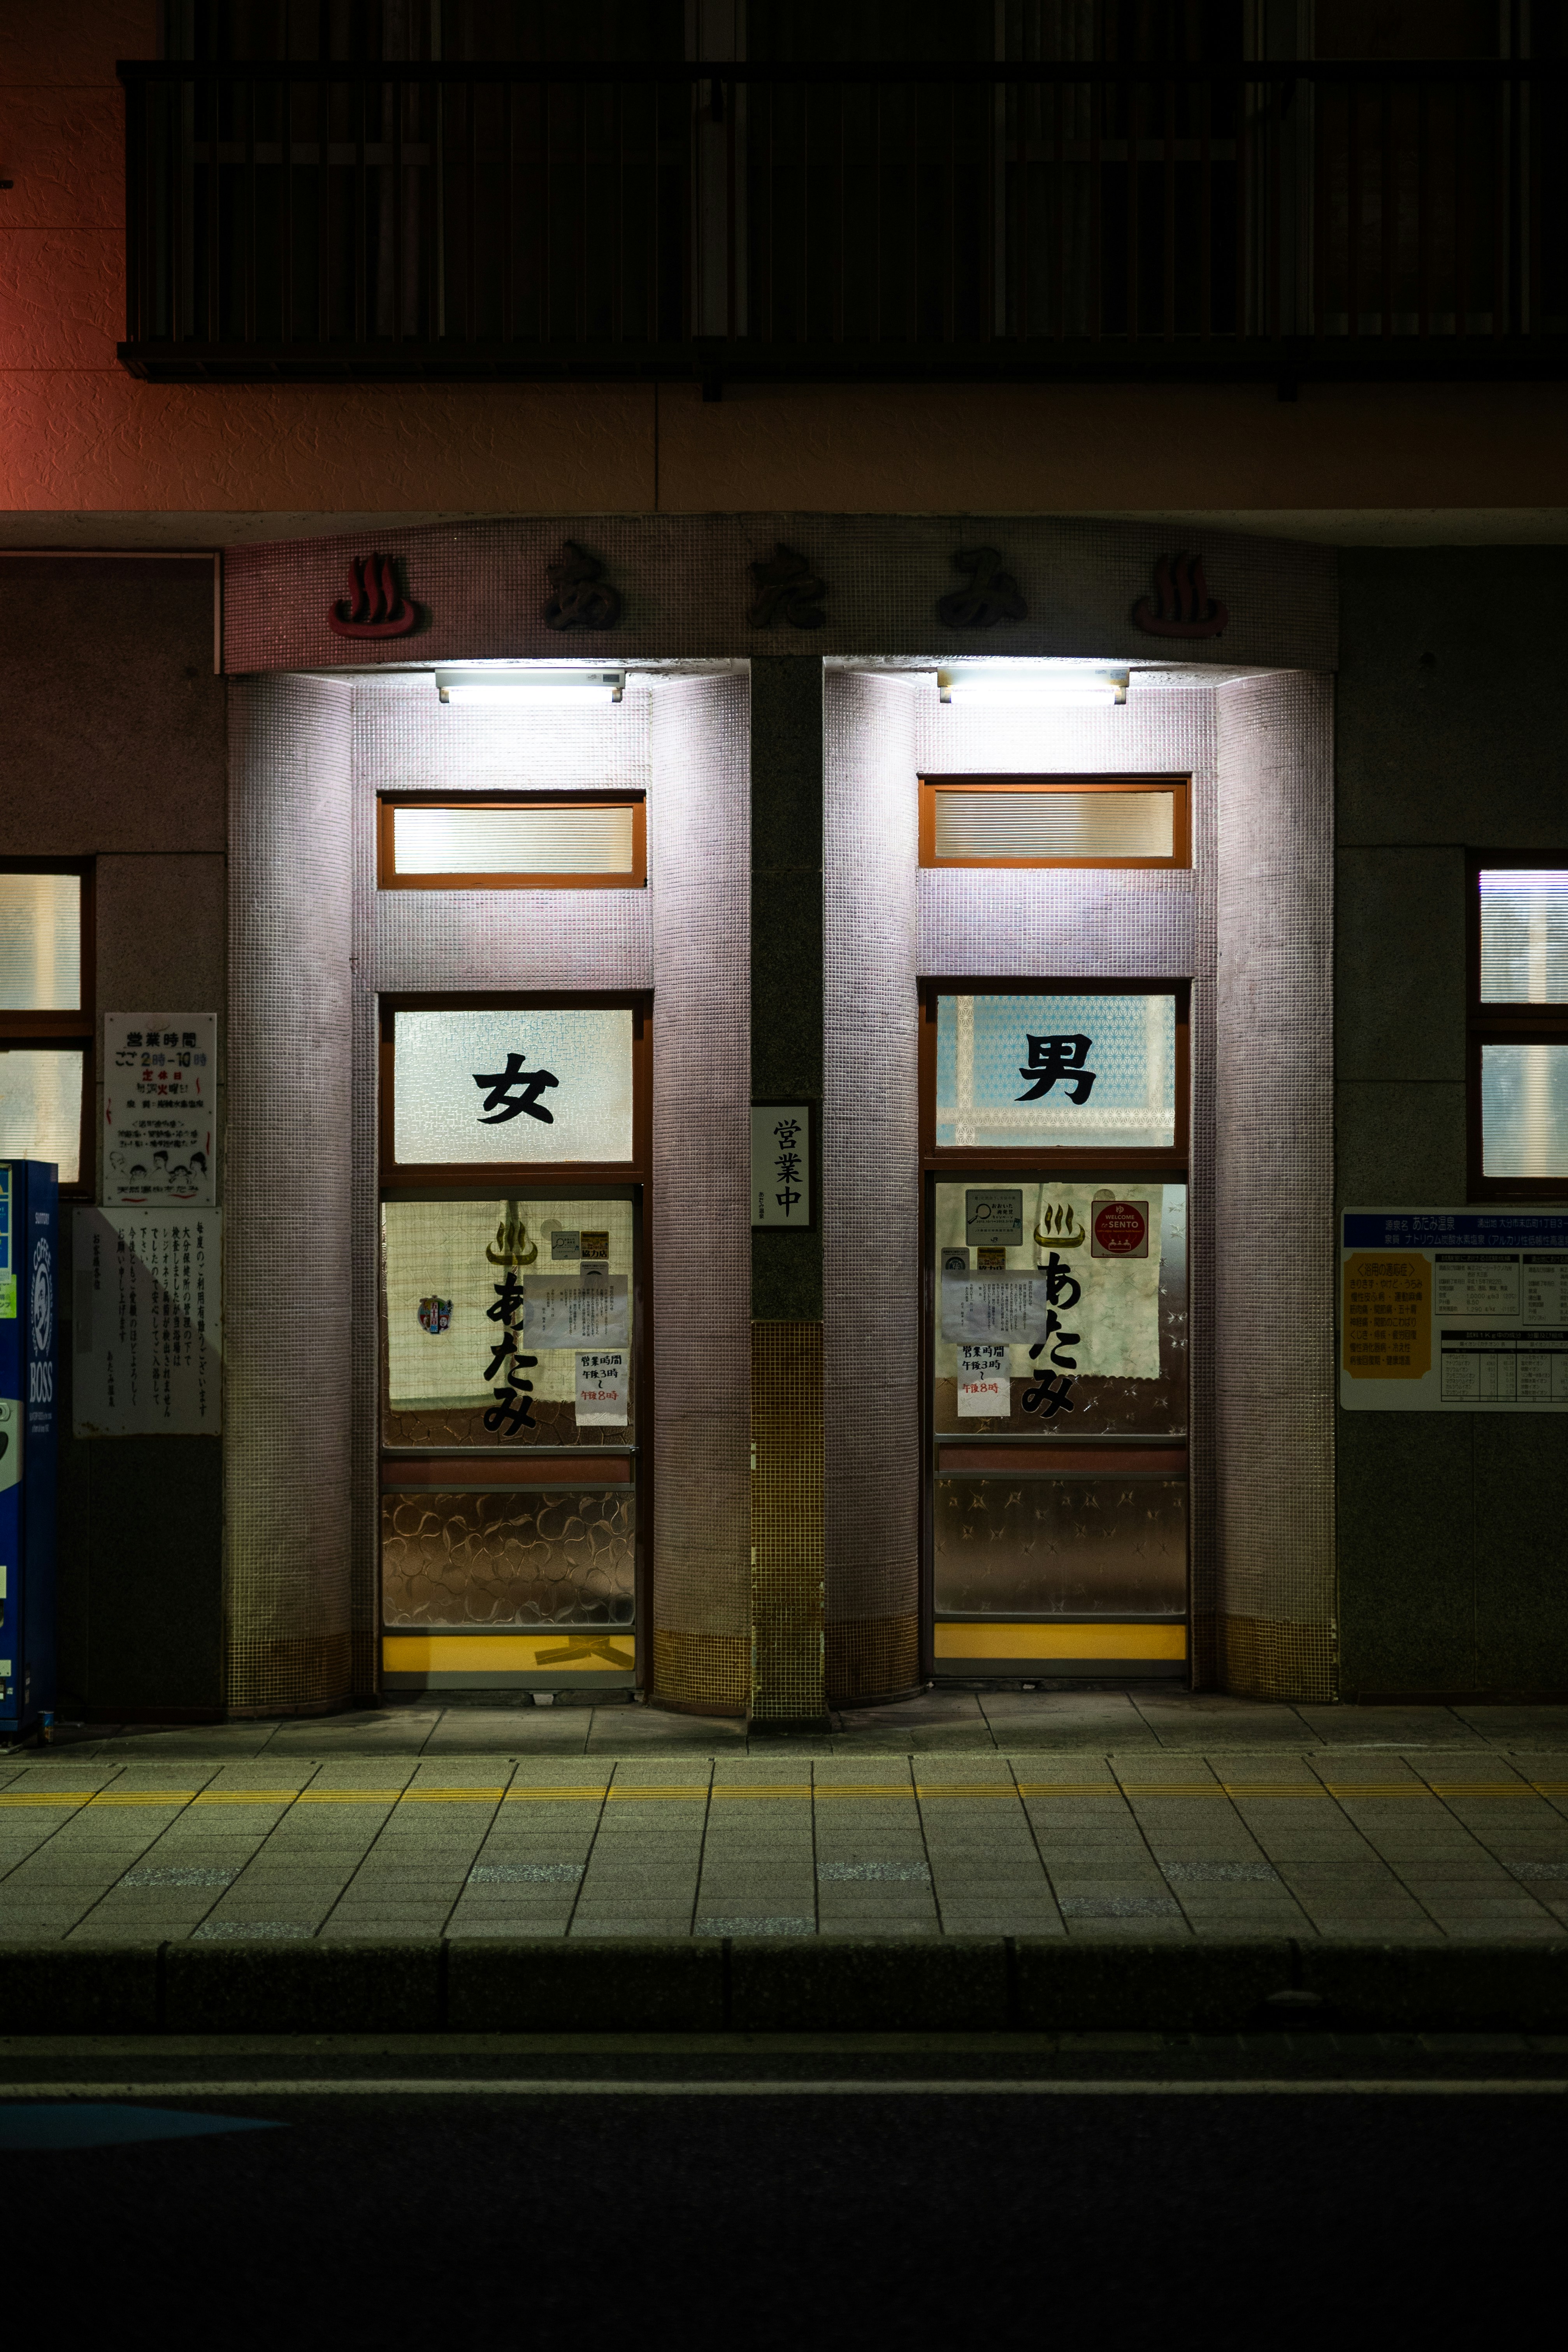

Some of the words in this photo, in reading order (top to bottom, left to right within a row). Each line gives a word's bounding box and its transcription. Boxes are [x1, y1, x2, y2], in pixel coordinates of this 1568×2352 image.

[127, 1032, 196, 1047] 営業時間
[142, 1069, 181, 1081] 定休日
[1015, 1033, 1097, 1105] 男
[471, 1052, 559, 1125] 女
[773, 1119, 803, 1217] 営業中
[1385, 1220, 1408, 1231] 源泉名
[1413, 1216, 1455, 1231] あたみ温泉
[1477, 1219, 1497, 1228] 湧出地
[1385, 1235, 1400, 1245] 泉質
[1022, 1251, 1081, 1418] あたみ
[483, 1272, 538, 1437] あたみ
[963, 1346, 1004, 1358] 営業時間
[581, 1355, 622, 1367] 営業時間
[962, 1360, 1001, 1370] 午後3時
[582, 1368, 618, 1379] 午後3時
[30, 1361, 53, 1403] BOSS
[962, 1383, 999, 1393] 午後8時
[580, 1391, 619, 1401] 午後8時
